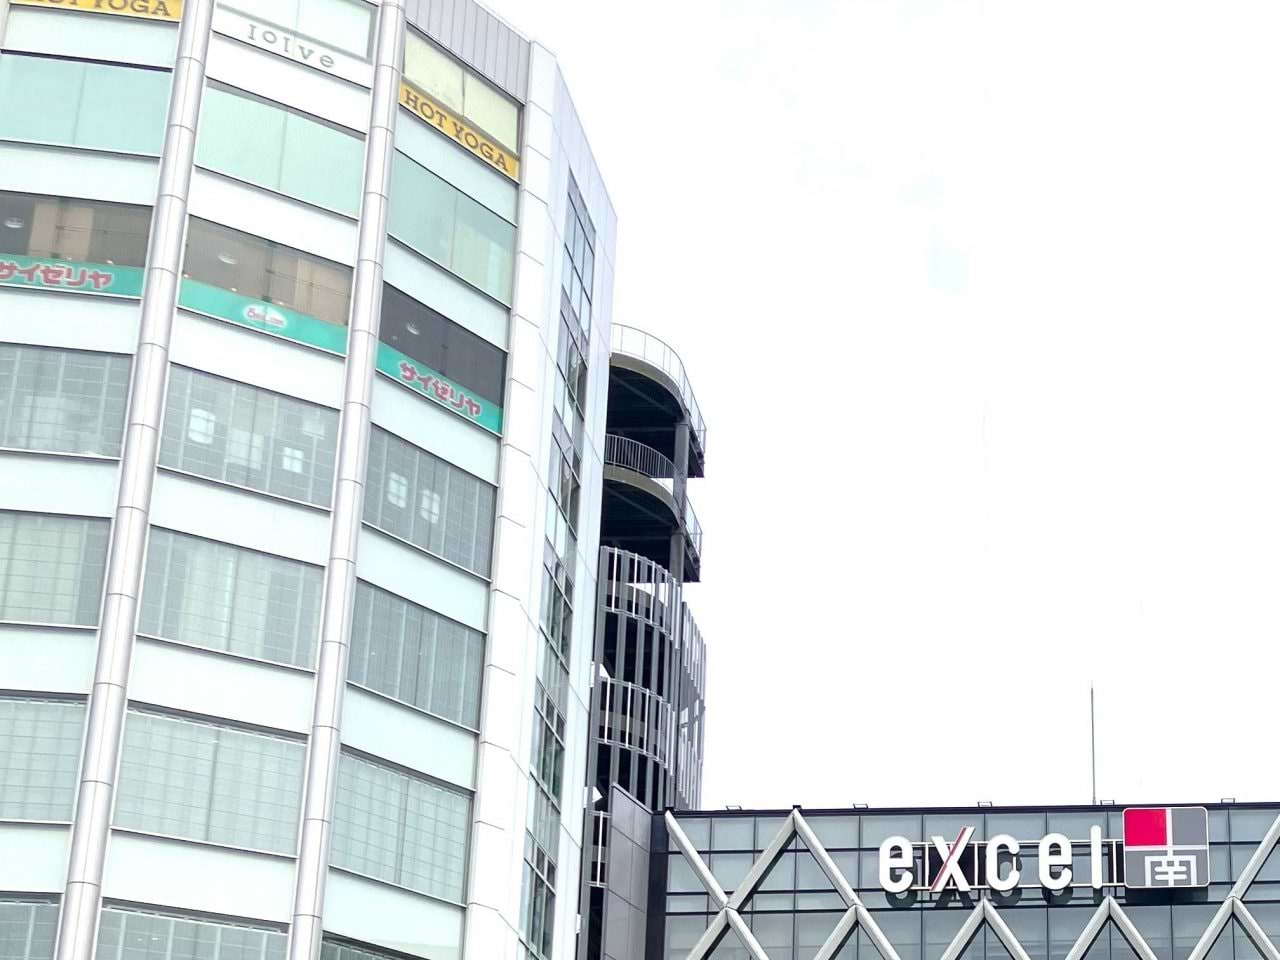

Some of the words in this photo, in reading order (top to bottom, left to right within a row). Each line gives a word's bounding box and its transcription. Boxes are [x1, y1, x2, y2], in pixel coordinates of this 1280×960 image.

[404, 89, 447, 128] HOT
[452, 119, 509, 172] YOGA
[0, 261, 113, 290] サイゼリヤ
[400, 361, 482, 417] サイゼリヤ
